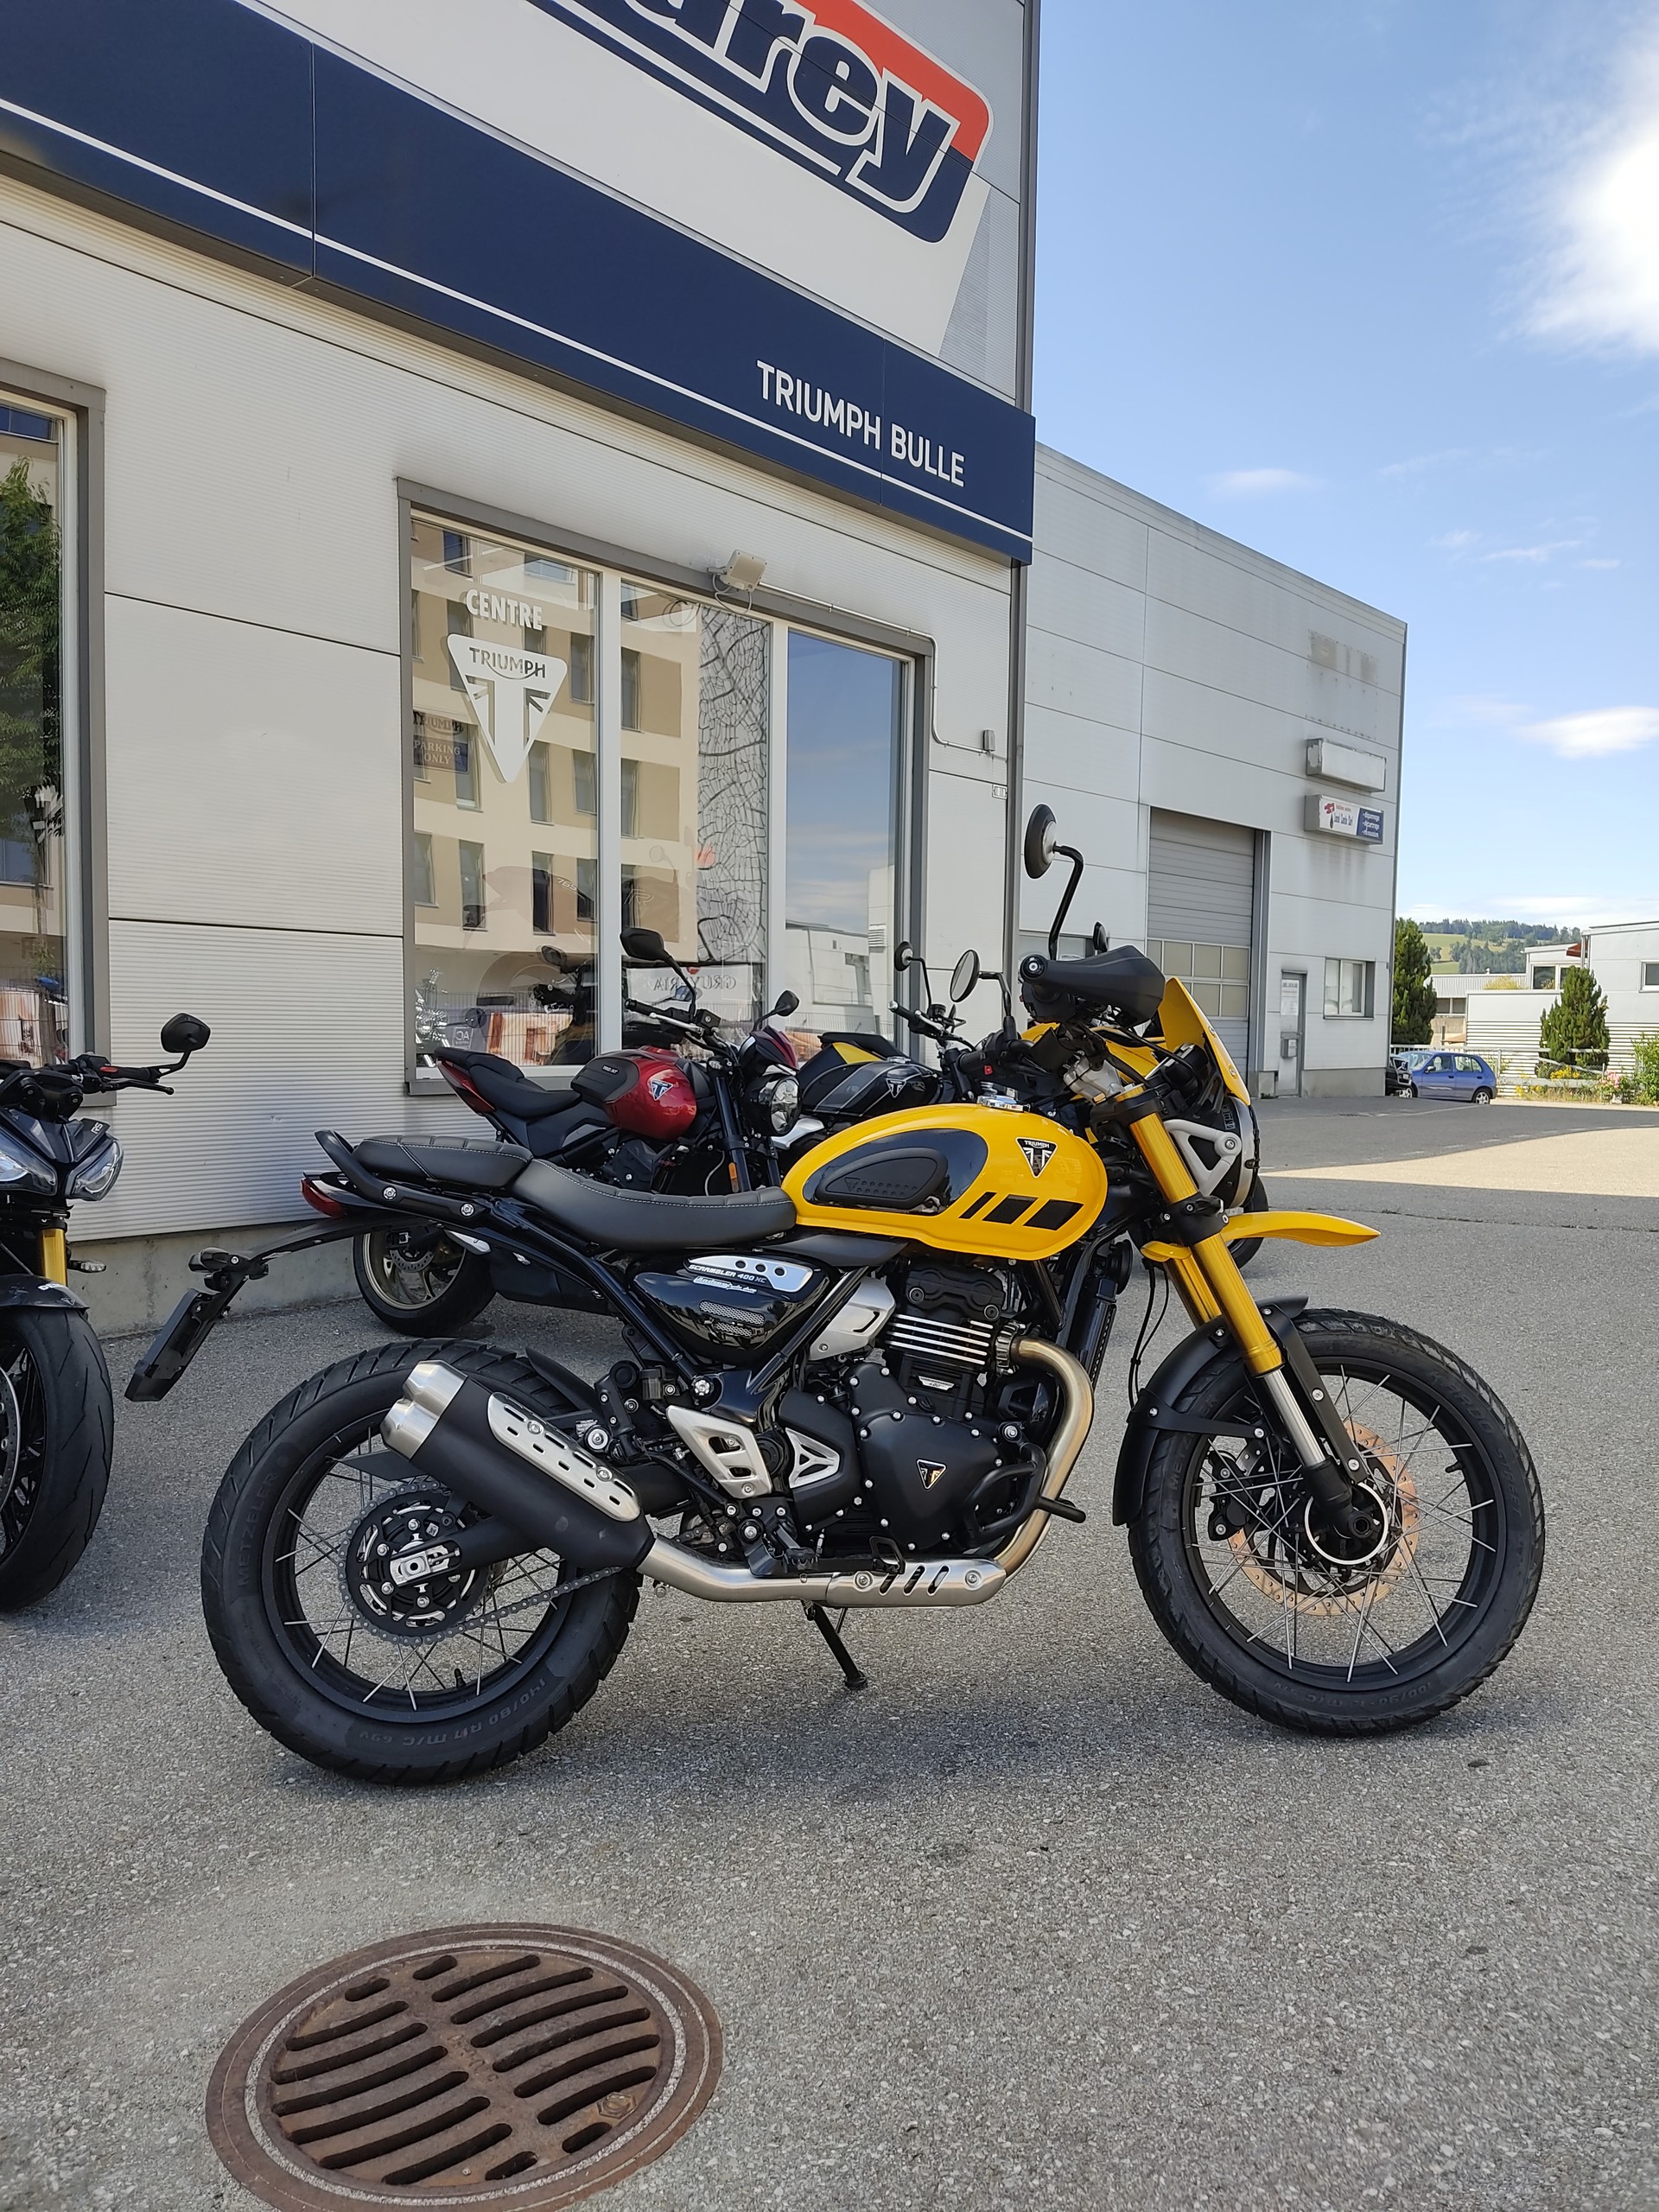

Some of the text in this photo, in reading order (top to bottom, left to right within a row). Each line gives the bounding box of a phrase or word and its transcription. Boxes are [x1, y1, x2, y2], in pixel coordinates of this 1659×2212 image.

[756, 359, 965, 487] TRIUMPH BULLE
[467, 588, 543, 631] CENTRE
[469, 646, 546, 680] TRIUMPH
[413, 711, 464, 735] TRIUMPH
[413, 740, 461, 755] PARKING
[424, 753, 451, 765] ONLY
[556, 877, 577, 891] 765
[1024, 1140, 1050, 1148] TRIUMPH
[688, 1264, 736, 1278] SCRAMBLER
[487, 1677, 546, 1726] 140/80
